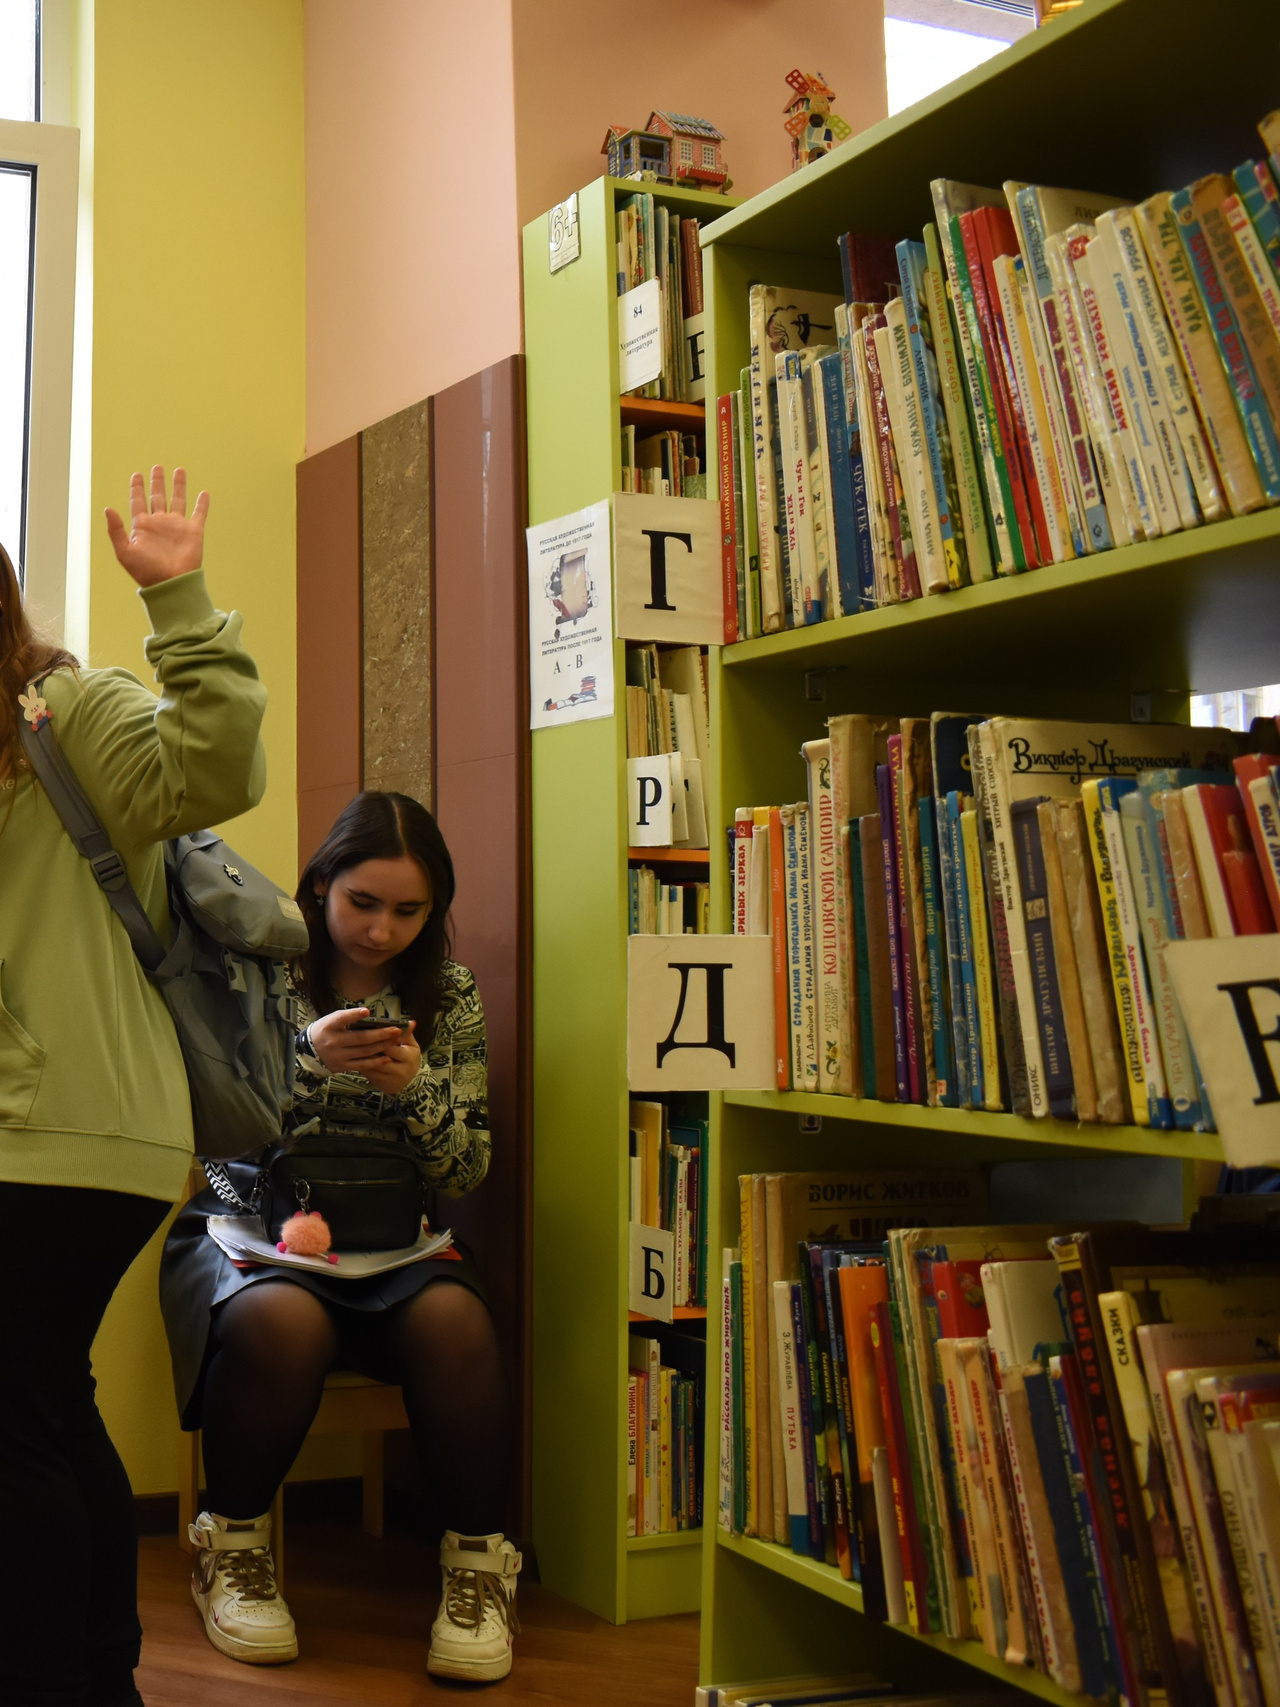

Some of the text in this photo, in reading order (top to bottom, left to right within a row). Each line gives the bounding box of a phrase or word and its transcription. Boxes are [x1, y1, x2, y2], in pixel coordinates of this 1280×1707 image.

[550, 206, 578, 252] 6+
[1120, 226, 1143, 272] УРОКОВ
[633, 304, 643, 318] 84
[1002, 288, 1018, 350] БУТЕРБРОДОВ
[1136, 276, 1170, 358] НЕВЫУЧЕННЫХ
[620, 327, 659, 351] Художественная
[626, 339, 653, 357] литература
[931, 271, 960, 402] СТОРОЖУ ЗЕМЛЯНИКУ
[893, 324, 922, 457] КОЖАНЫЕ БАШМАКИ
[914, 349, 929, 403] АМУРЧИК
[967, 357, 982, 408] ГЕОРГИЕВ
[1142, 369, 1155, 398] СТРАНЕ
[1163, 364, 1184, 401] СТРАНЕ
[742, 379, 751, 441] АРКАДИЙ ГАЙДАР
[754, 414, 764, 460] ЧУК
[1096, 441, 1109, 480] ГЕРАСКИНА
[1158, 420, 1176, 467] ГЕРАСКИНА
[1188, 433, 1205, 474] ГЕРАСКИНА
[721, 420, 731, 530] ШАНХАЙСКИЙ СУВЕНИР
[795, 459, 803, 482] Чук
[881, 441, 892, 487] ГАМАЗКОВА
[1150, 464, 1164, 504] ГЕРАСКИНА
[786, 494, 796, 551] ЧУК ГЕК
[852, 463, 868, 534] ЧУК ГЕК
[887, 488, 895, 507] Инна
[920, 489, 934, 556] АННА ГАРФ
[540, 522, 595, 546] РУССКАЯ ХУДОЖЕСТВЕННАЯ
[540, 543, 565, 555] ЛИТЕРАТУРА
[572, 537, 580, 545] 1917
[581, 533, 592, 541] ГОДА
[761, 521, 770, 571] АРКАДИЙ
[641, 529, 692, 611] Г
[541, 627, 597, 647] РУССКАЯ ХУДОЖЕСТВЕННАЯ
[541, 635, 602, 656] ЛИТЕРАТУРА ПОСЛЕ 1917 ГОДА
[553, 654, 583, 674] А В
[1008, 737, 1086, 785] Виктор
[1088, 739, 1192, 775] Драгунский
[636, 776, 662, 826] Р
[787, 825, 798, 869] СЕМЁНОВА
[921, 846, 933, 889] зверята
[990, 792, 1014, 911] Виктор Драгунский ХИТРЫЙ
[788, 871, 798, 899] ИВАНА
[819, 794, 838, 975] КОЛЛОВСКОЙ САПФИР
[789, 902, 801, 964] ВТОРОГОДНИКА
[799, 811, 815, 1051] Давыдычев СТРАДАНИЯ ВТОРОГОДНИКА ИВАНА СЕМЁНОВА
[925, 901, 935, 936] Звери
[958, 913, 970, 962] Двадцать
[791, 969, 802, 1026] СТРАДАНИЯ
[928, 949, 940, 999] Дмитриев
[656, 963, 736, 1069] Д
[824, 980, 832, 1033] АНТОНИНА
[831, 985, 839, 1030] ДЕЛЬВИГ
[930, 1002, 941, 1031] Юрий
[964, 982, 976, 1044] Драгунский
[1032, 932, 1060, 1075] ВИКТОР ДРАГУНСКИЙ
[1126, 945, 1144, 1025] Драгоценная
[1141, 1027, 1151, 1064] банда
[970, 1048, 979, 1086] Виктор
[1028, 1064, 1042, 1106] ОНИКС
[808, 1180, 970, 1202] БОРИС ЖИТКОВ
[641, 1246, 665, 1300] Б
[1109, 1308, 1129, 1366] СКАЗКИ
[822, 1352, 832, 1404] ХРАНИМИРЫ
[947, 1378, 959, 1425] ЗАХОДЕР
[628, 1386, 636, 1466] Елена БЛАГИНИНА
[786, 1407, 797, 1450] ПУТЬКА
[841, 1377, 853, 1433] ХРАНИМИРЫ
[961, 1475, 975, 1536] ШКОЛЬНИКА
[970, 1380, 1014, 1613] ХРЕСТОМАТИЯ ШКОЛЬНИКА БОРИС ЗАХОДЕР
[1181, 1525, 1200, 1582] Галоши
[1219, 1489, 1255, 1595] ЗОЩЕНКО
[971, 1540, 985, 1610] ХРЕСТОМАТИЯ
